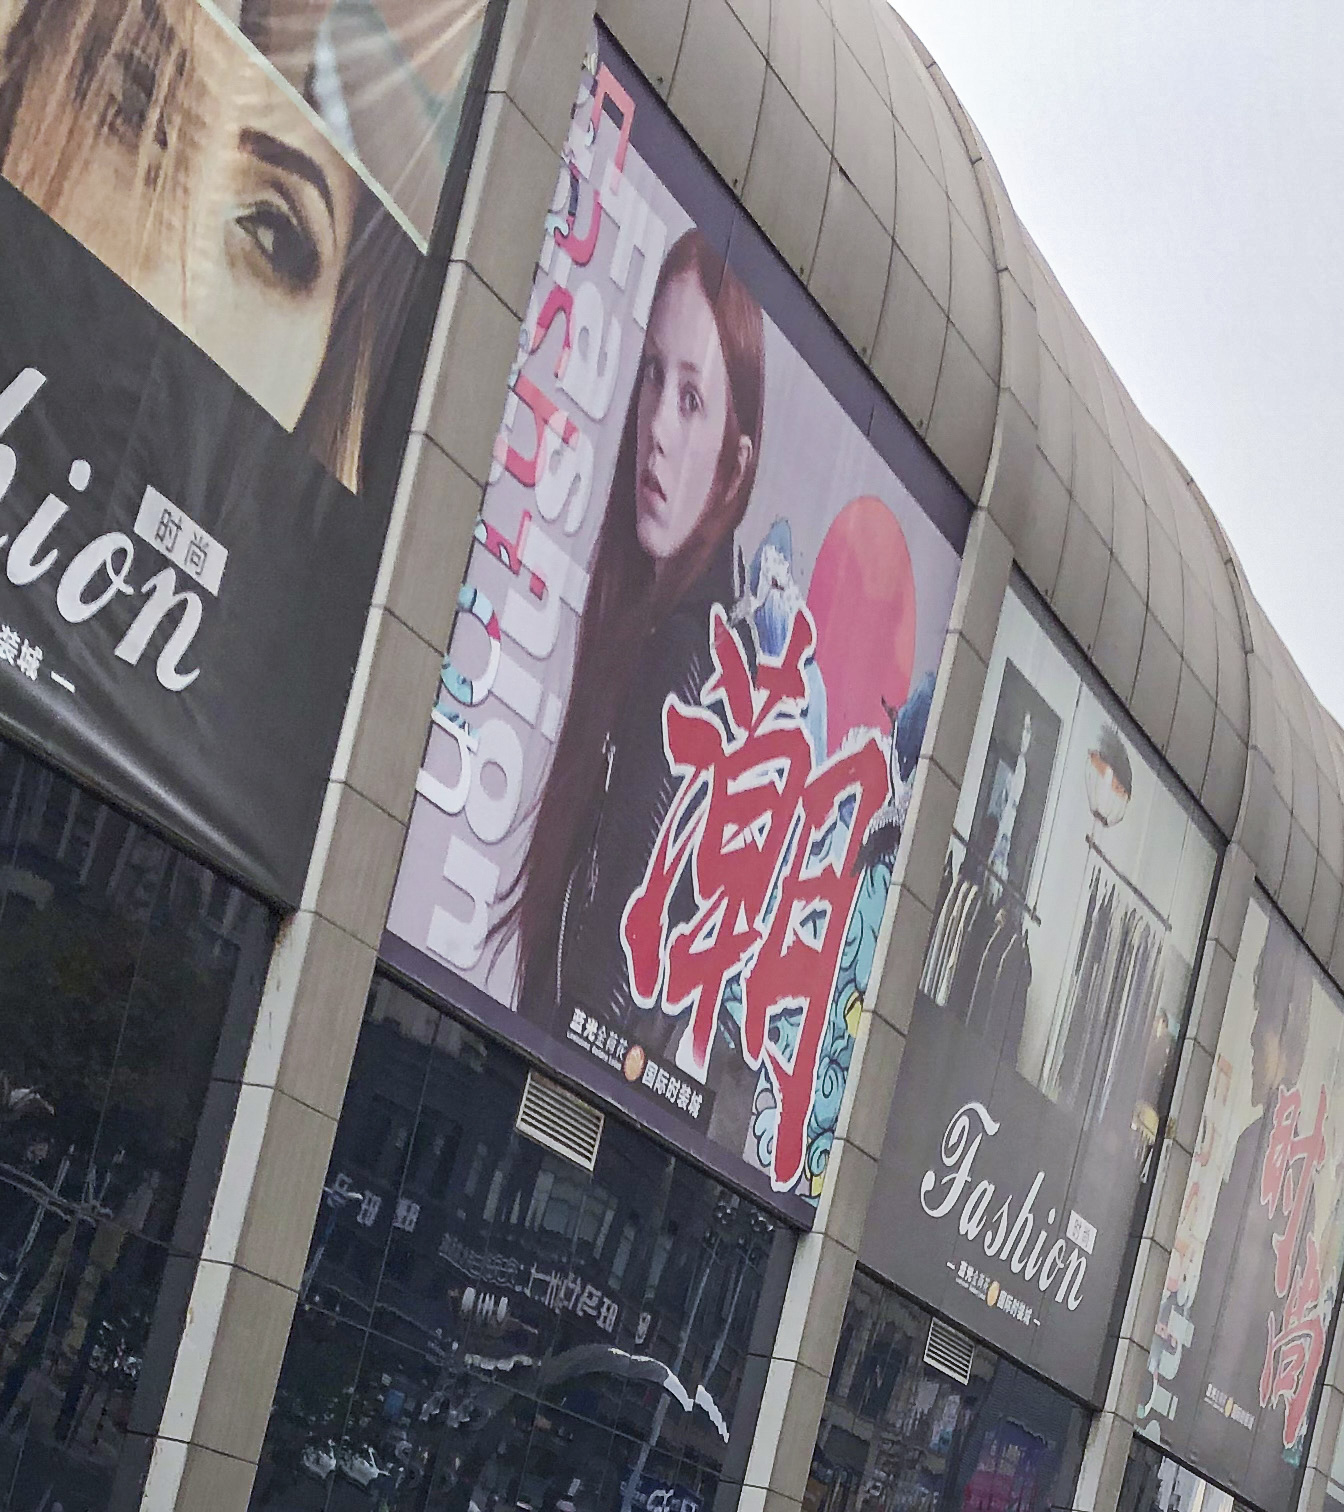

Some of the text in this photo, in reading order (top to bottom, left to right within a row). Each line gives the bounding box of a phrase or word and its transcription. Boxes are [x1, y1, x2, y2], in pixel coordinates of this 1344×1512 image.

[154, 508, 210, 576] 时尚
[426, 158, 667, 970] Fashion
[621, 602, 889, 1191] 潮
[920, 1101, 1087, 1312] Fashion
